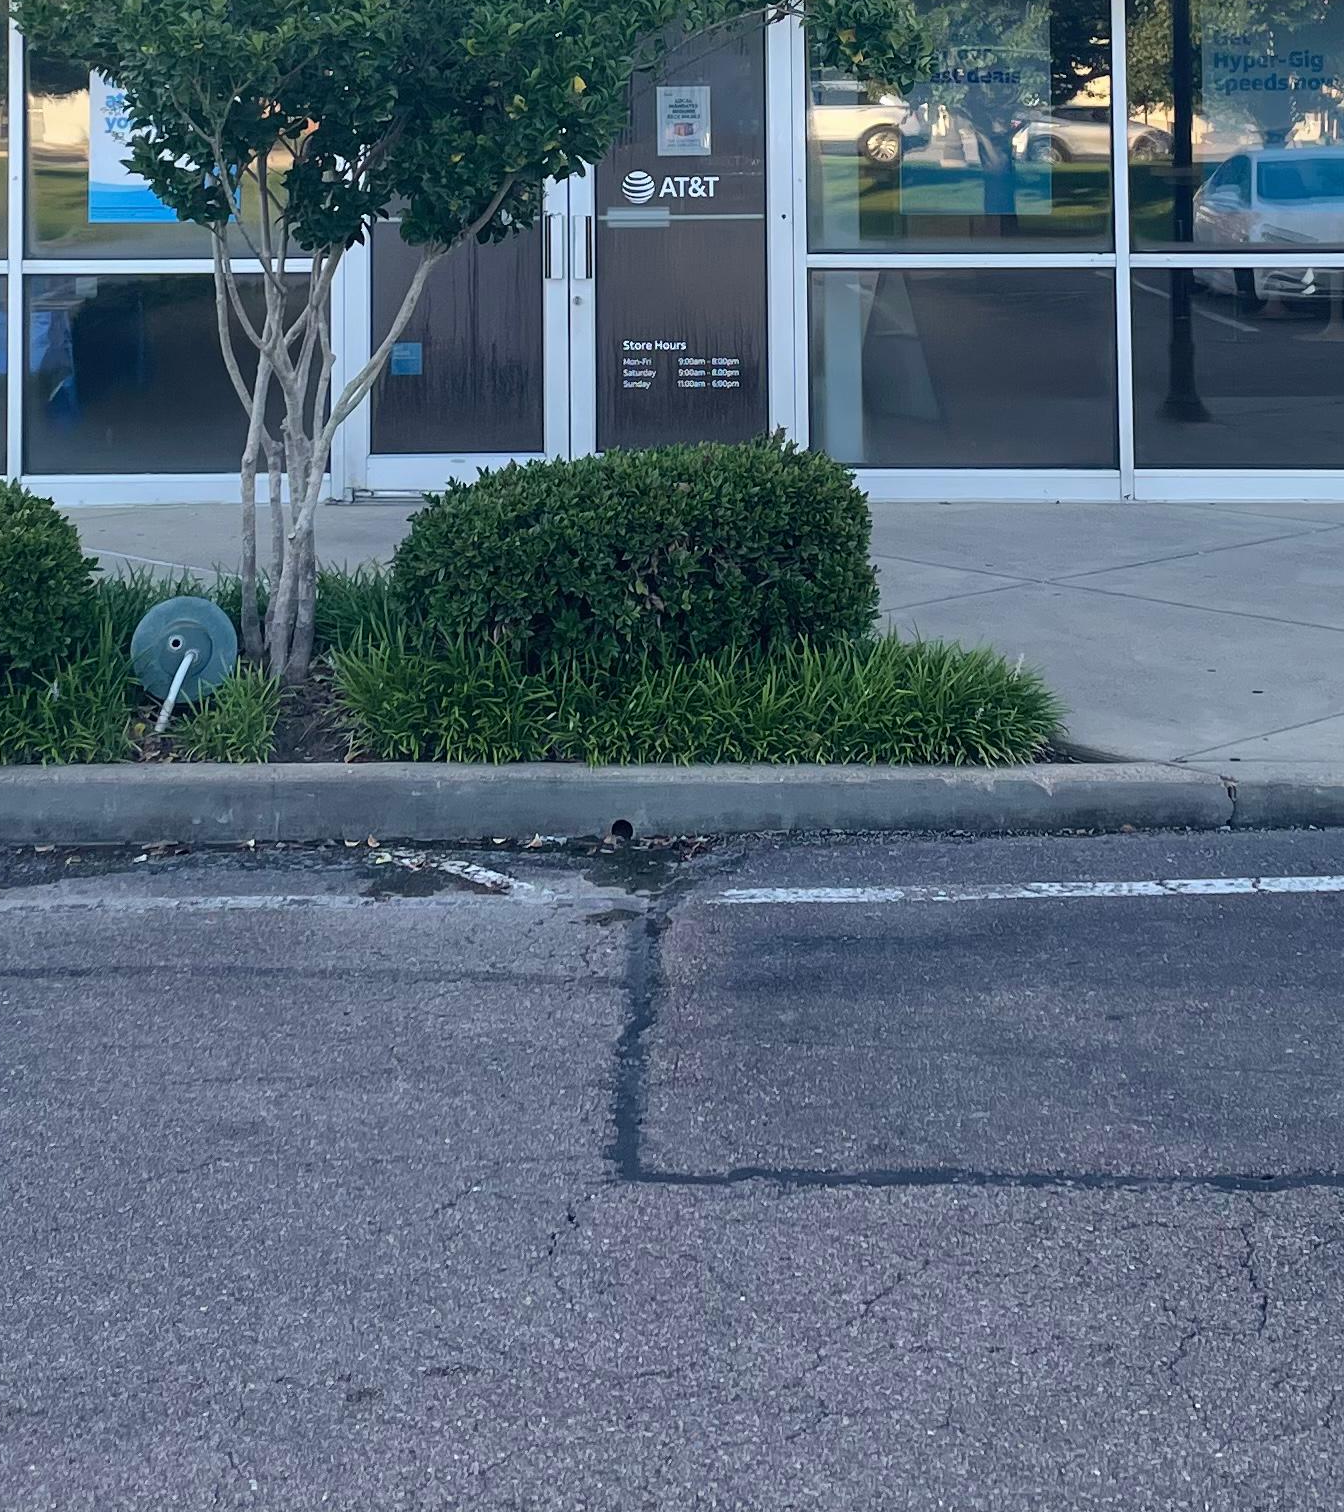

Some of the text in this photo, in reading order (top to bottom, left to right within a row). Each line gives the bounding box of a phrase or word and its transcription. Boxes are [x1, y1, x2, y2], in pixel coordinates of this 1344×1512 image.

[1213, 51, 1324, 73] Hyper-Gig
[1213, 73, 1288, 96] speeds
[659, 176, 720, 198] AT&T
[623, 340, 687, 350] Store Hours
[623, 369, 657, 378] Saturday
[623, 380, 652, 389] Sunday
